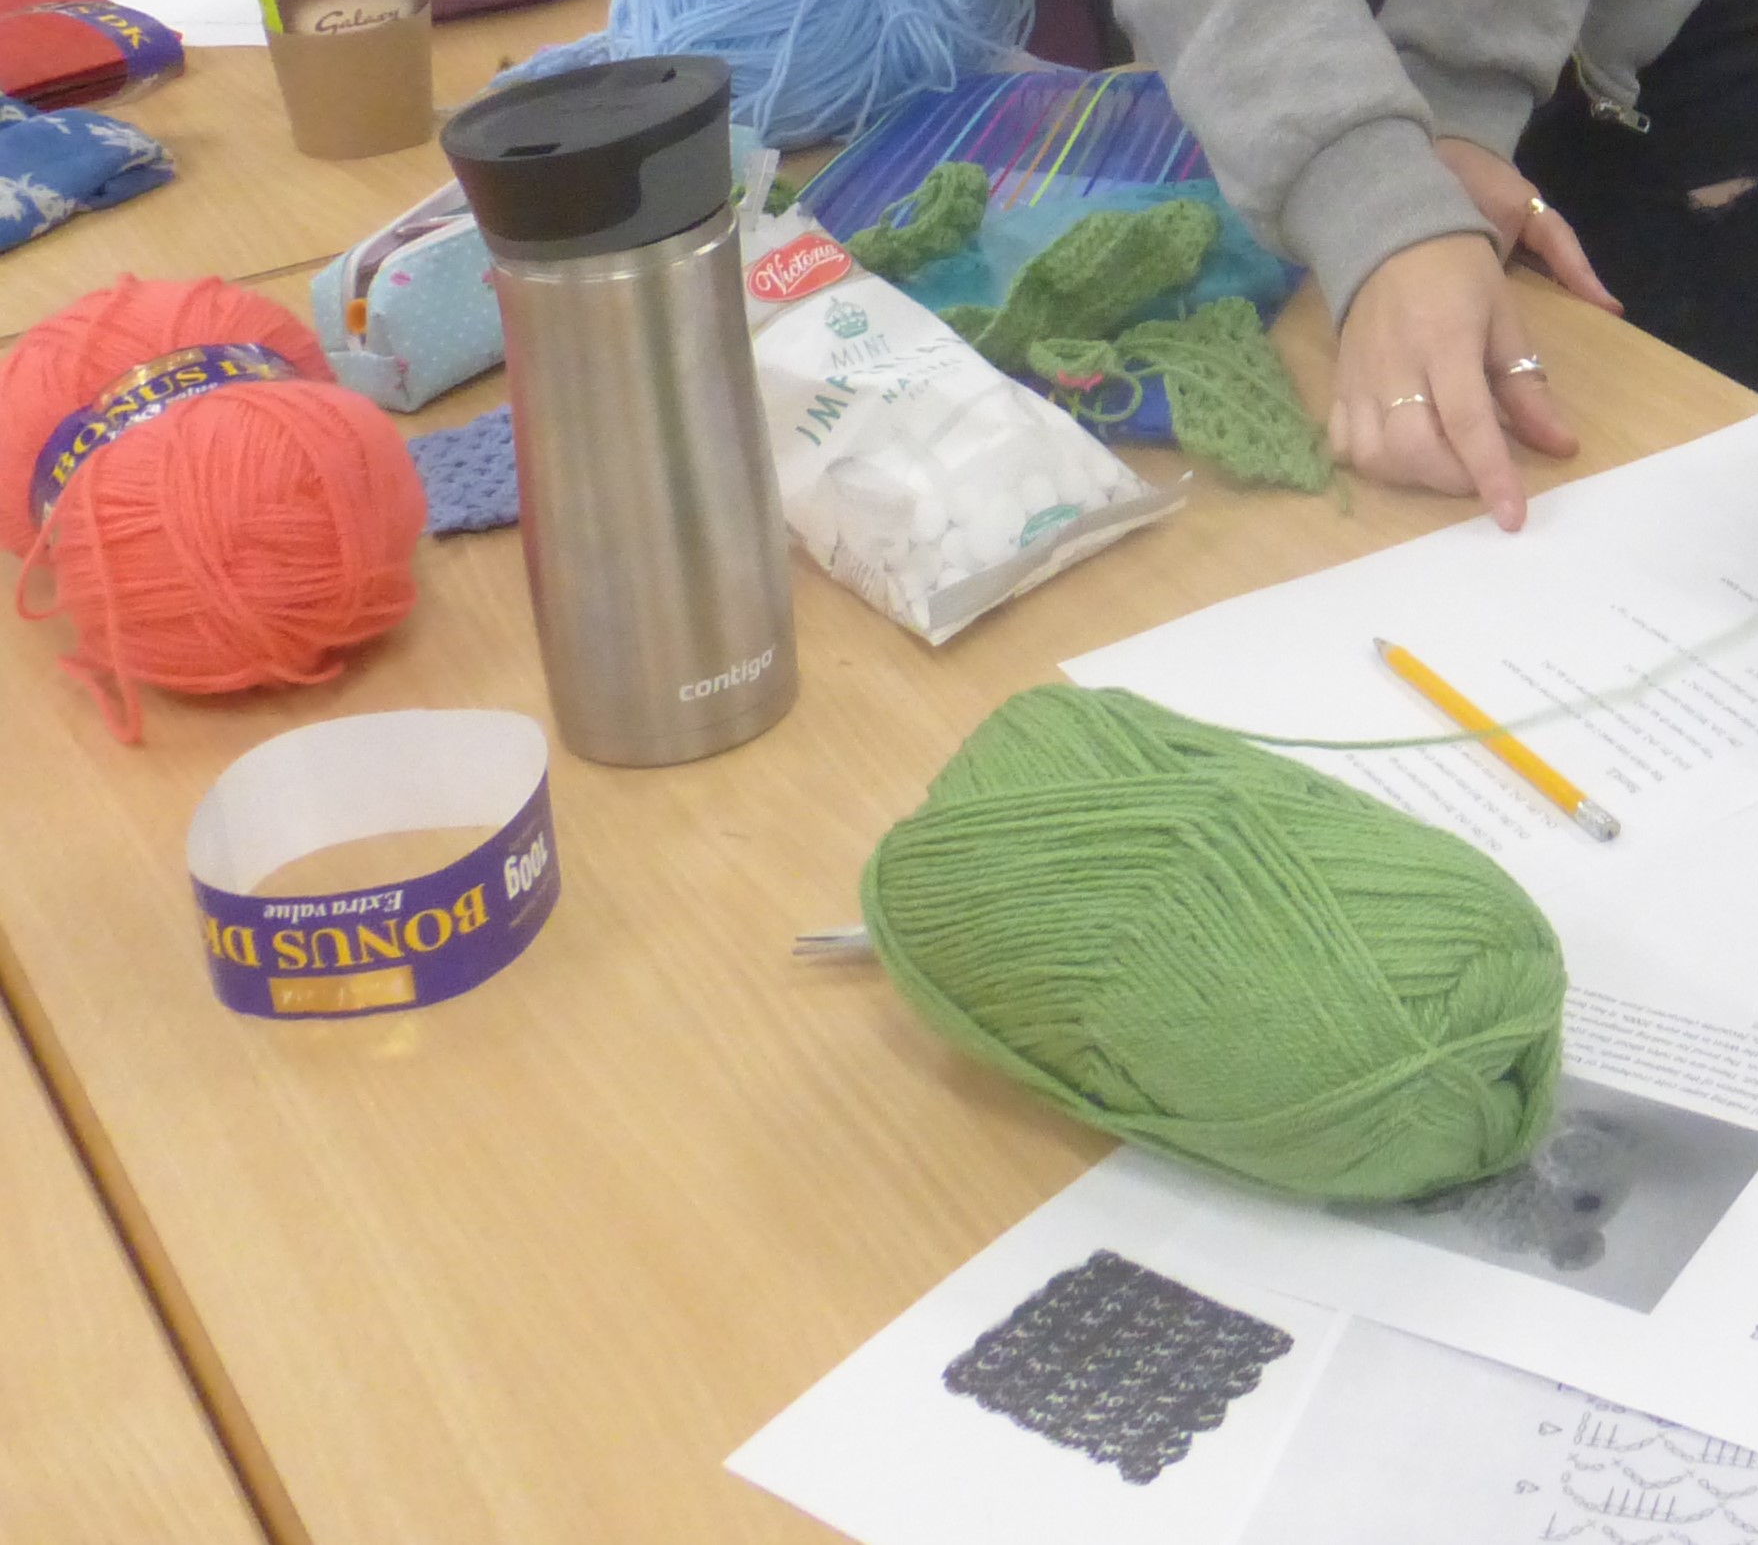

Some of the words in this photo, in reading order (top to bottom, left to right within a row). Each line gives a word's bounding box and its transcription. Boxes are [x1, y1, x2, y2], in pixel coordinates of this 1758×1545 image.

[99, 14, 151, 49] DK
[315, 8, 399, 35] Galaxy
[755, 242, 845, 296] Victoria
[830, 333, 892, 370] MINT
[52, 366, 208, 486] BONUS
[679, 648, 773, 703] contigo
[503, 831, 549, 900] 100g
[263, 903, 327, 924] value
[331, 889, 404, 917] Extra
[271, 883, 490, 970] BONUS
